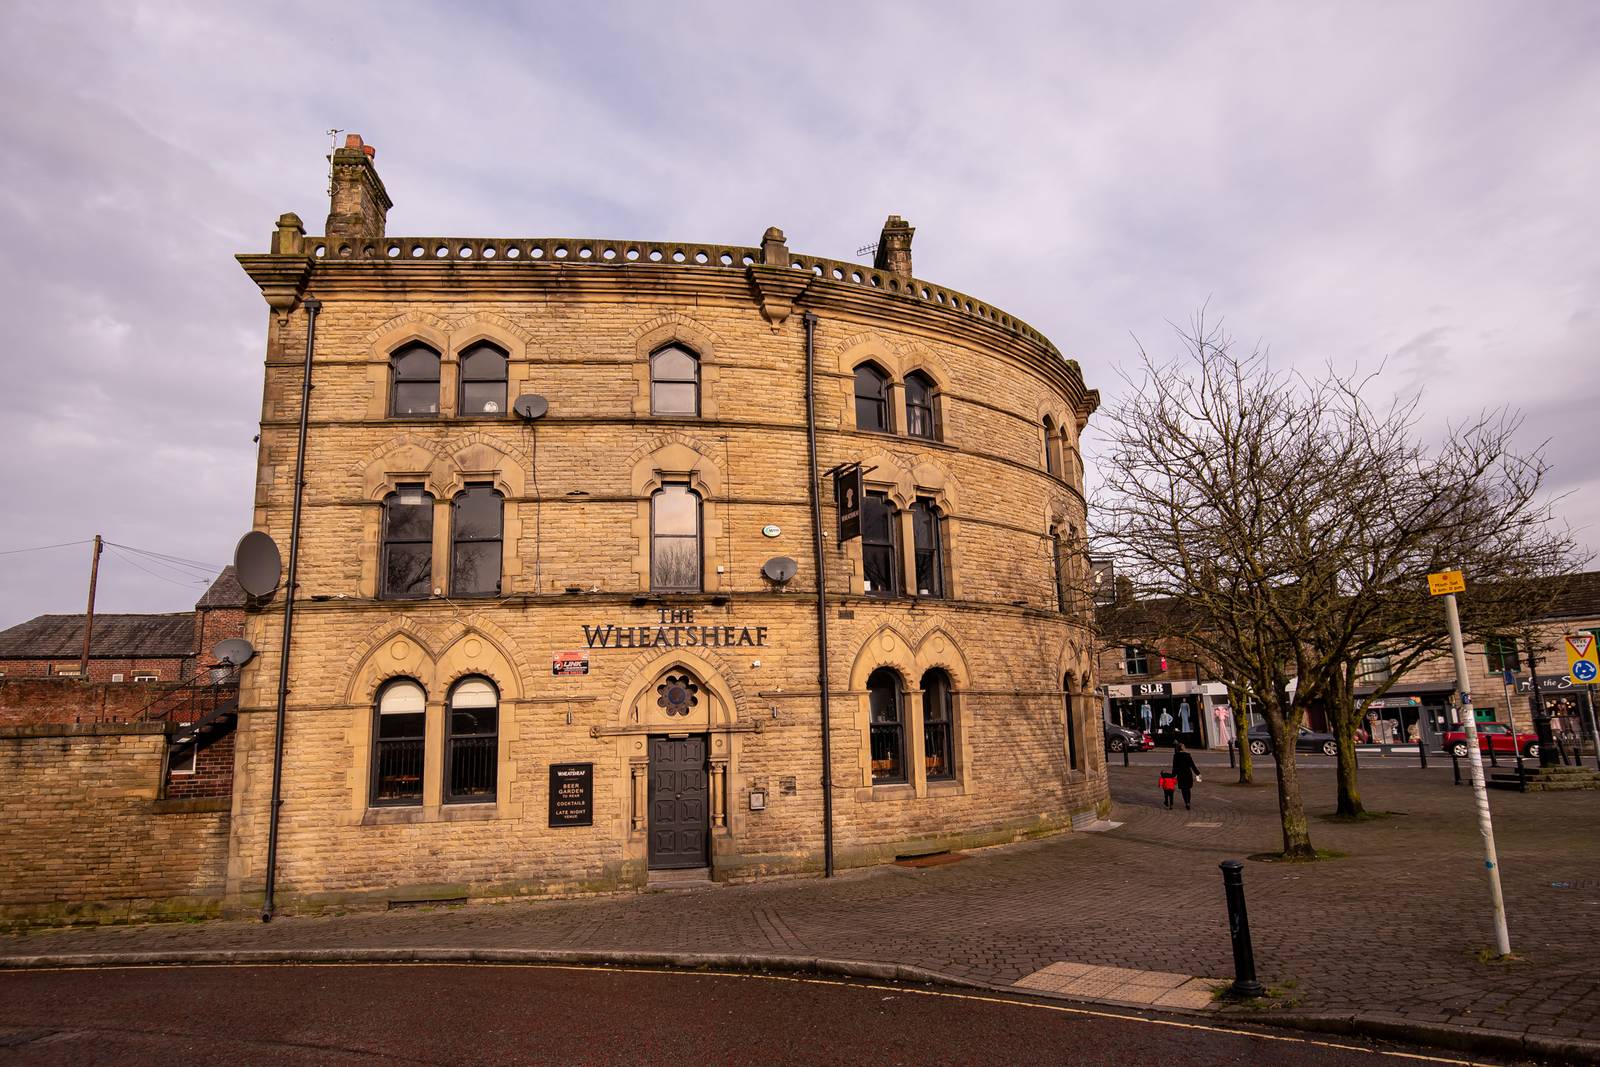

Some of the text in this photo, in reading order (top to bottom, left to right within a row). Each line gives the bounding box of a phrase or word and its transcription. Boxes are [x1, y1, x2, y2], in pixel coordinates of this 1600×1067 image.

[657, 608, 695, 624] THE
[582, 624, 768, 649] WHEATSHEAF
[1140, 684, 1164, 693] SLB
